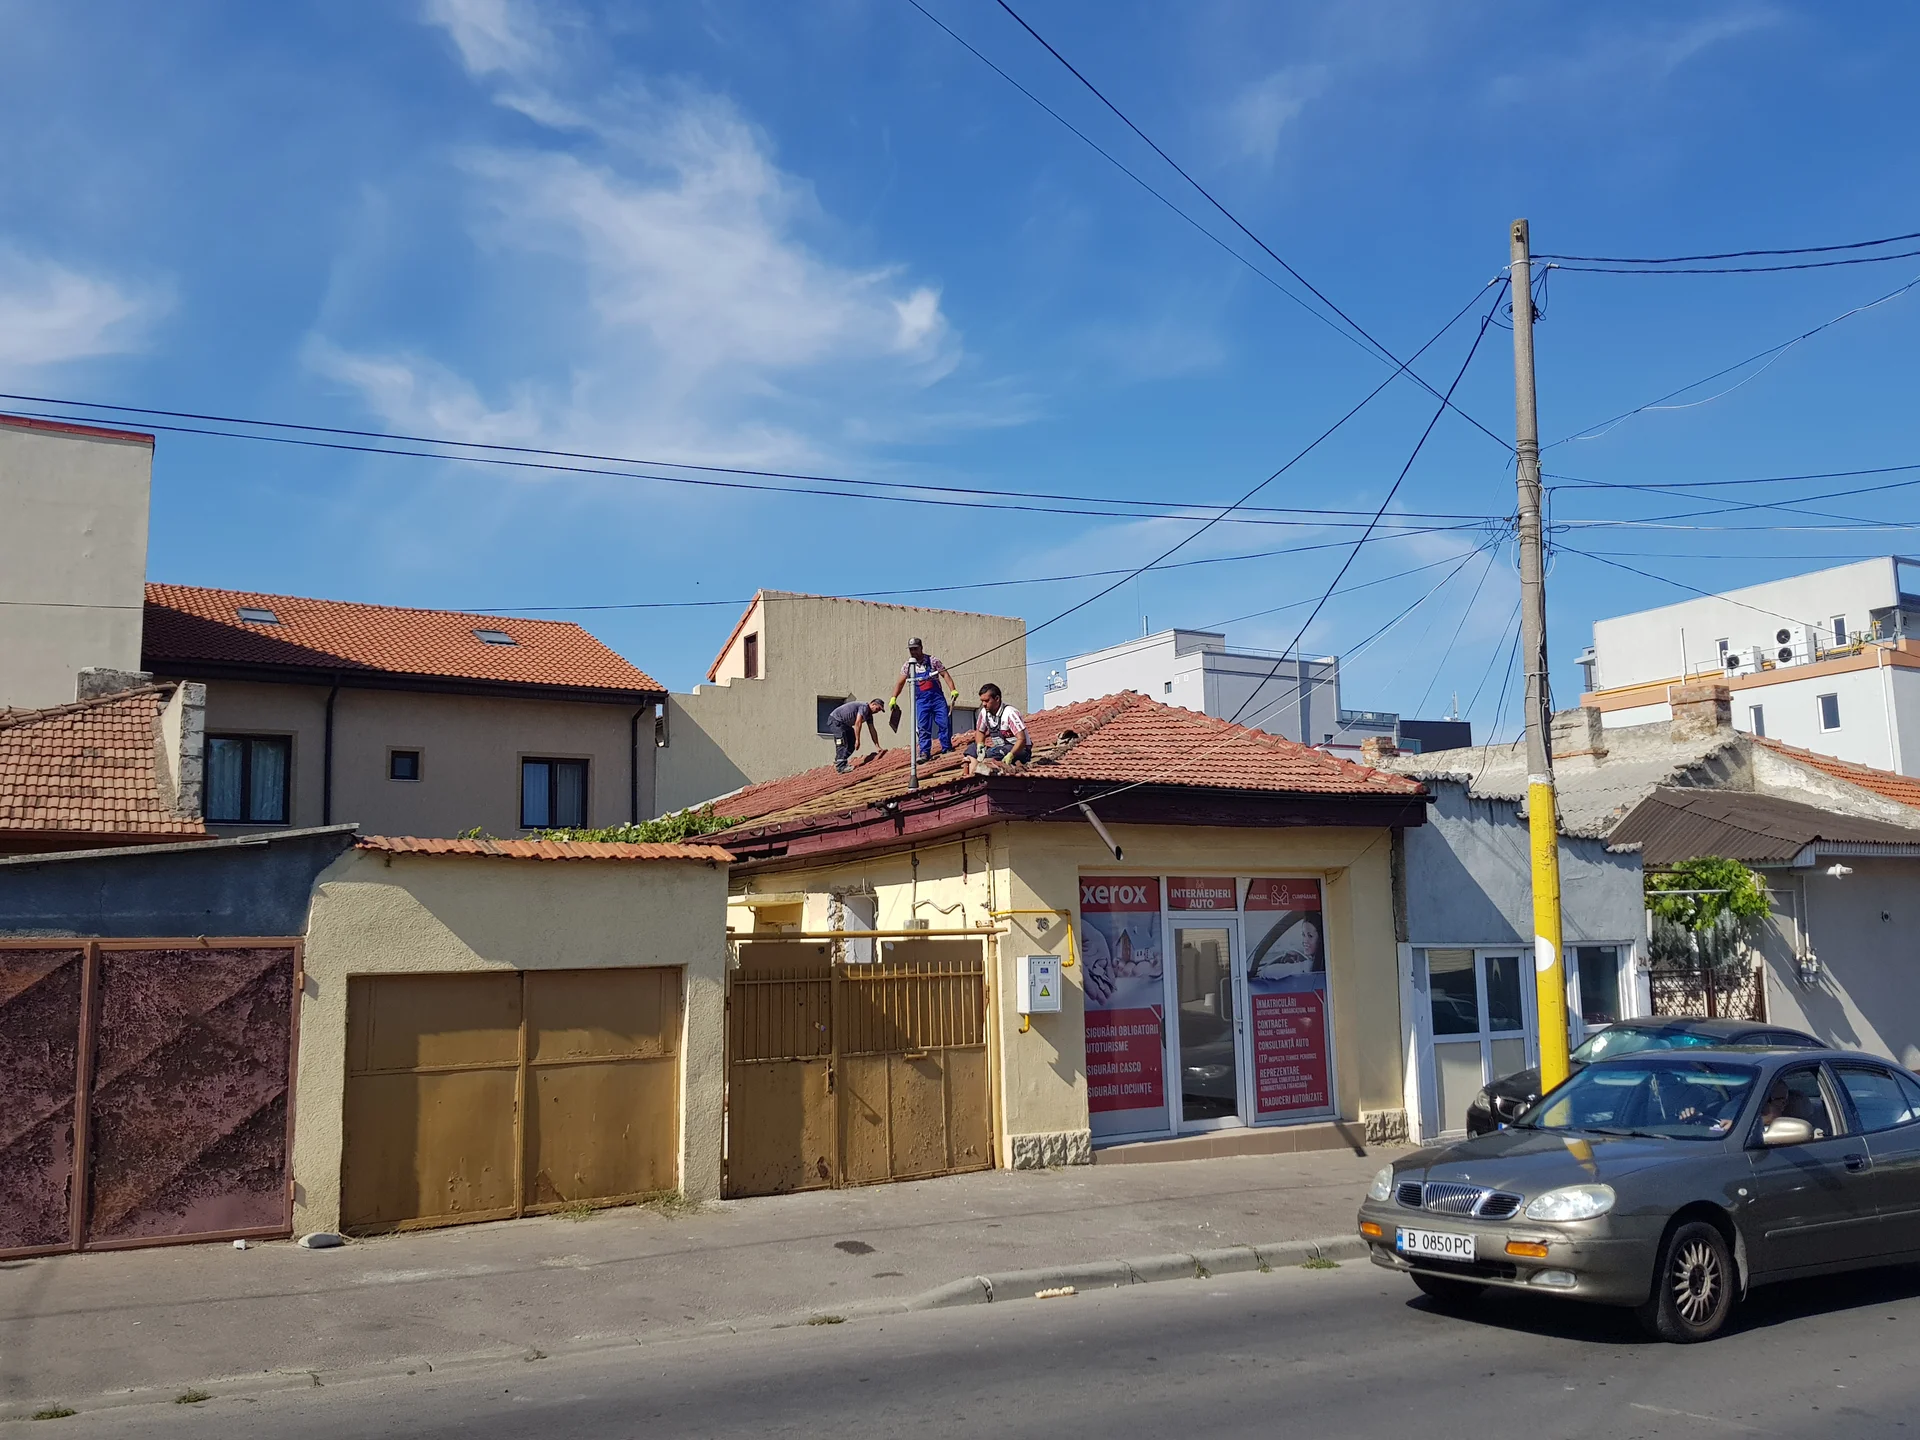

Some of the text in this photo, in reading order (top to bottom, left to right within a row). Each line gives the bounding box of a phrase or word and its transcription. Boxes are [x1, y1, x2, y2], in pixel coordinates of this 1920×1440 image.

[1081, 885, 1147, 904] xerox
[1171, 888, 1231, 899] INTERMEDIERI
[1189, 899, 1214, 909] AUTO
[1257, 1018, 1288, 1029] CONTRACTE
[1119, 1024, 1159, 1037] OBLIGATORII
[1295, 1038, 1309, 1048] AUTO
[1258, 1054, 1268, 1063] ITP
[1119, 1061, 1142, 1074] CASCO
[1260, 1066, 1300, 1078] REPREZENTARE
[1261, 1092, 1323, 1107] TRADUCERI AUTORIZATE
[1408, 1232, 1472, 1255] B 0850 PC
